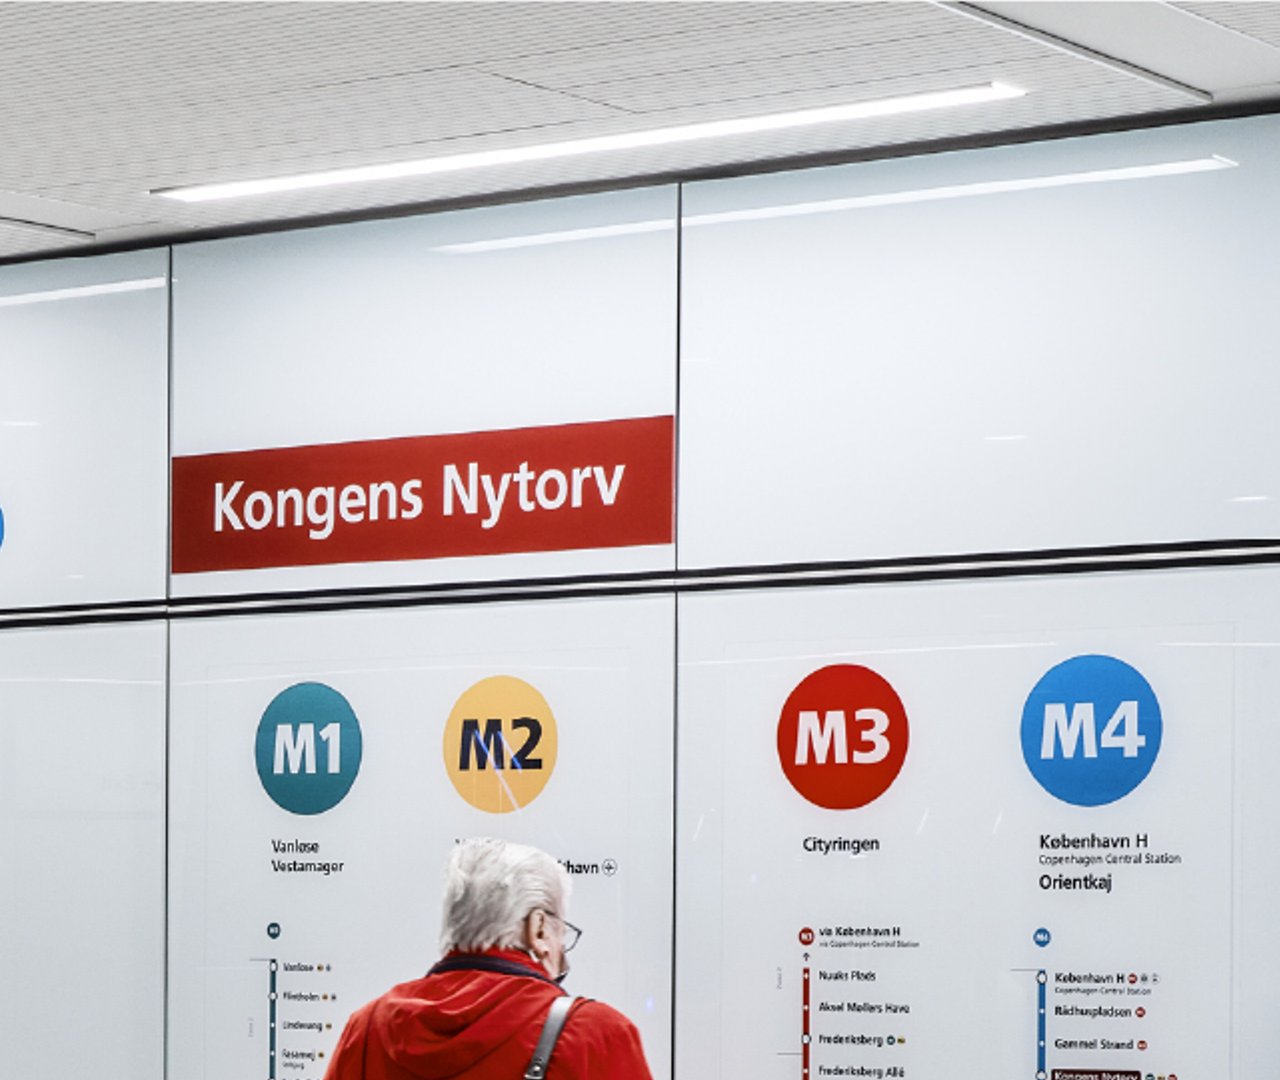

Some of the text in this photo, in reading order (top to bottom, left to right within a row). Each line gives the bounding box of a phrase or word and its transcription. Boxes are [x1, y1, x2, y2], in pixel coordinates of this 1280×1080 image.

[213, 462, 625, 540] Kongens Nytorv
[794, 707, 891, 766] M3
[1040, 700, 1146, 760] M4
[272, 722, 342, 775] M1
[458, 716, 543, 771] M2
[271, 839, 319, 853] Vanløse
[803, 837, 880, 855] Cityringen
[1040, 834, 1148, 849] København H
[271, 859, 344, 876] Vestamager
[1039, 853, 1182, 867] Copenhagen Central Station
[1039, 874, 1112, 893] Orientkaj
[835, 927, 890, 937] København
[893, 927, 900, 936] H
[1055, 973, 1124, 984] København H
[1055, 1006, 1131, 1019] Rådhuspladsen
[819, 1035, 883, 1047] Frederiksberg
[819, 1066, 883, 1079] Frederiksberg
